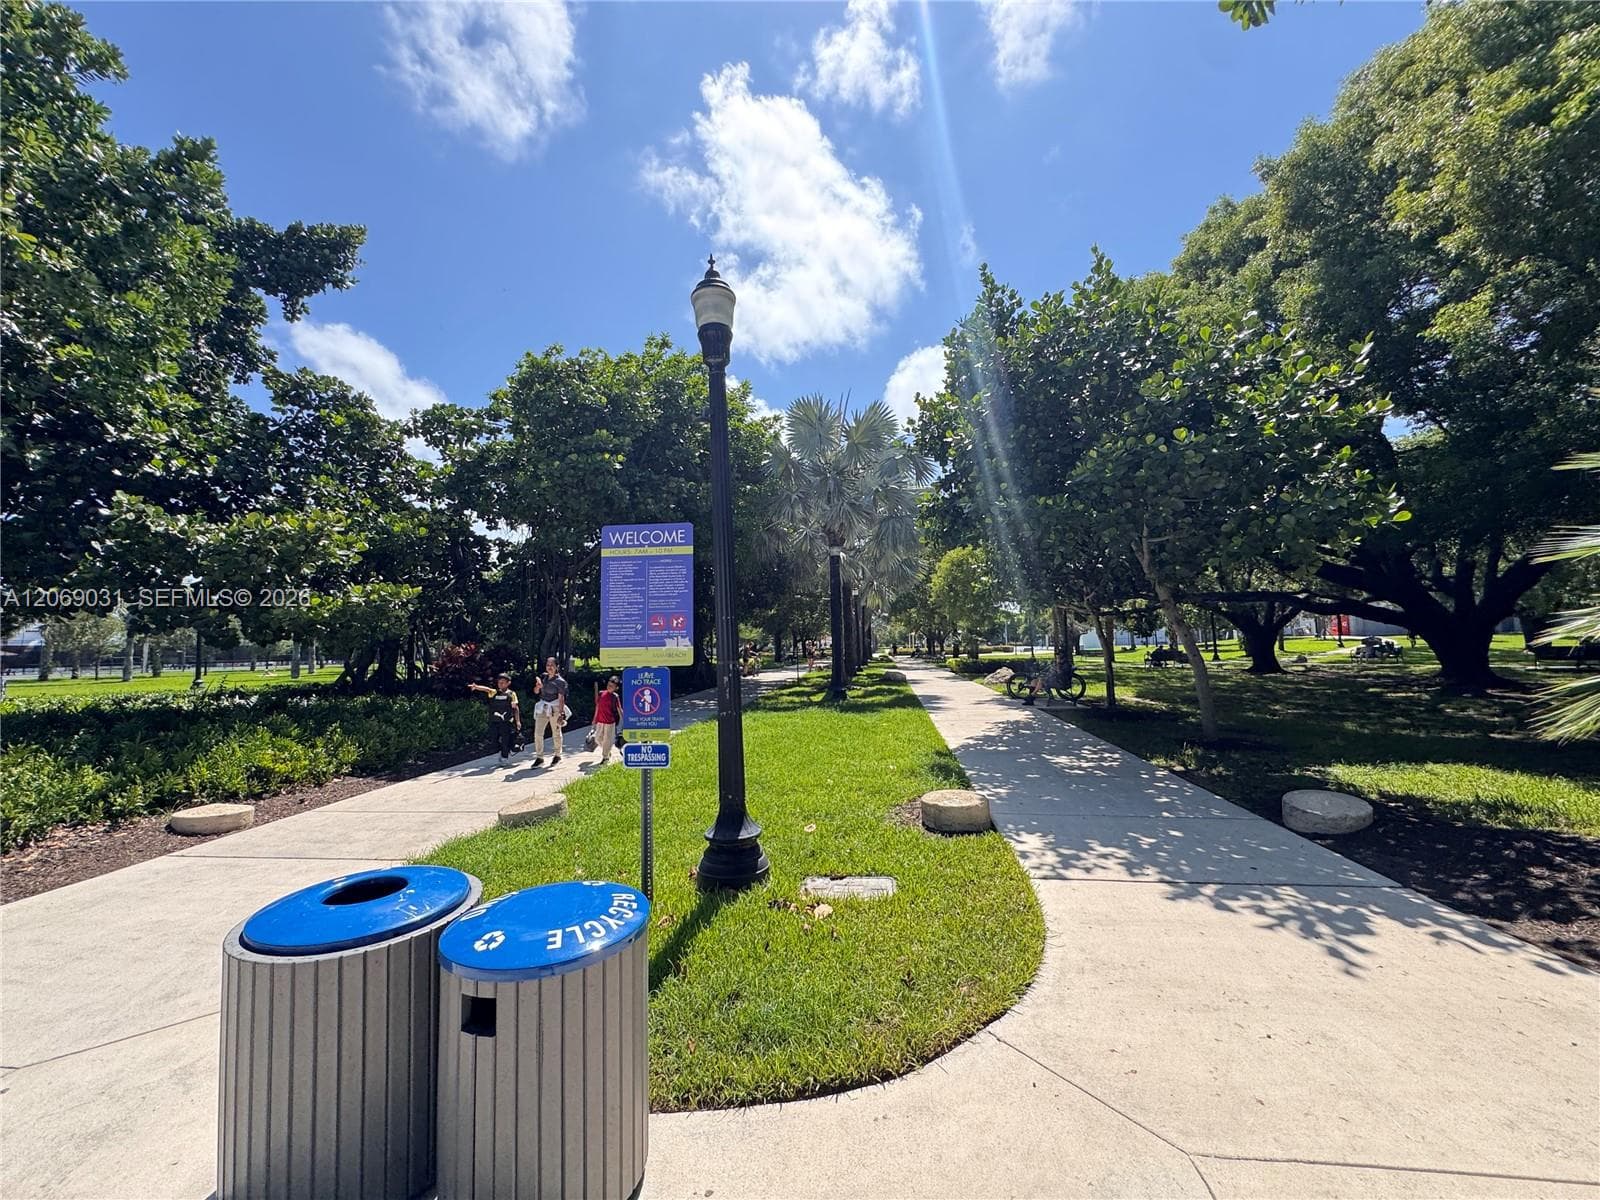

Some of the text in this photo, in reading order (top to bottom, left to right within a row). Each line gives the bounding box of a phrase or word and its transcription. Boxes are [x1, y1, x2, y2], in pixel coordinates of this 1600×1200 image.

[609, 529, 686, 545] WELCOME
[641, 745, 653, 753] NO
[627, 753, 666, 761] TRESPASSING
[546, 893, 638, 950] RECYCLE
